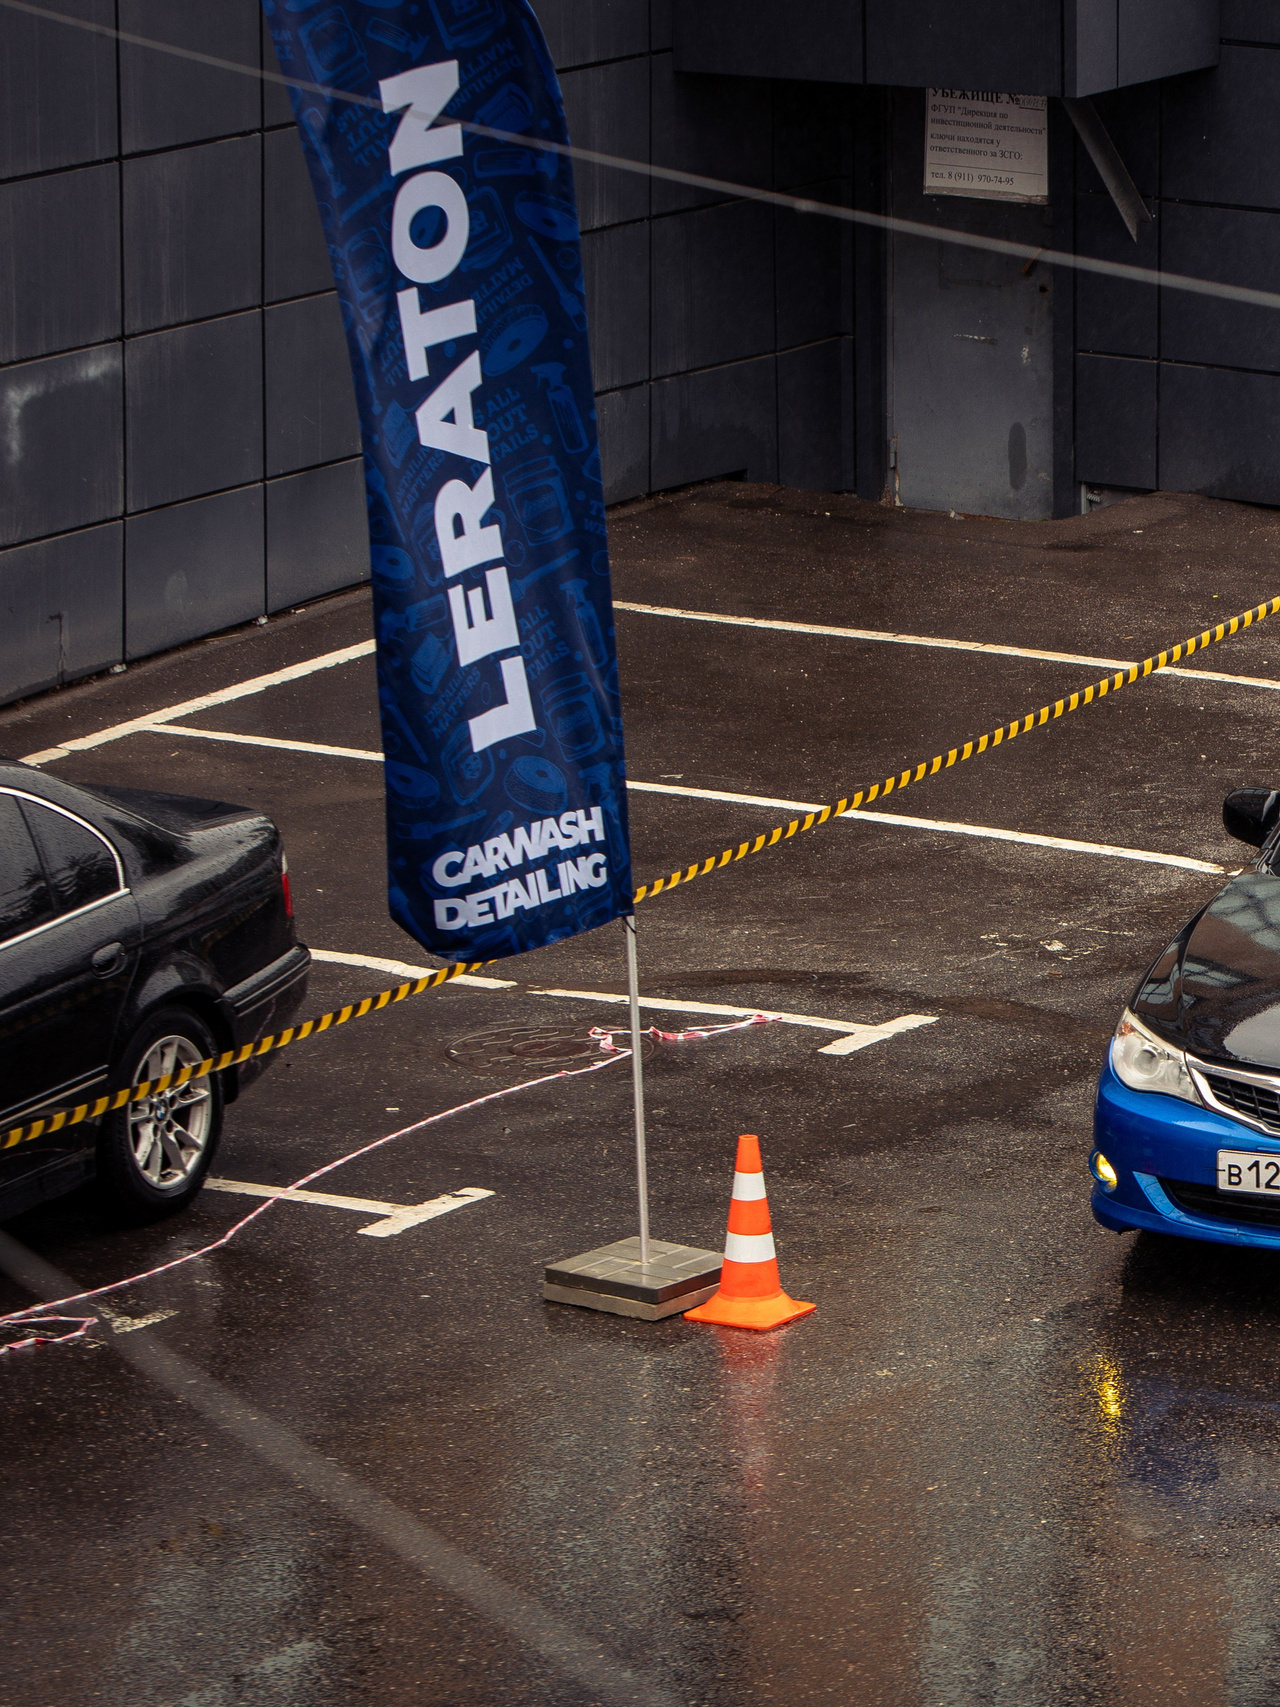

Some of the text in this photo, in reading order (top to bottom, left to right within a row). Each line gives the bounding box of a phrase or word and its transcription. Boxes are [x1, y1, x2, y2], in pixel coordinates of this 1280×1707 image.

[931, 104, 956, 114] ФГУП
[957, 107, 997, 118] "Дирекция
[930, 118, 1046, 135] инвестиционной деятельности"
[930, 133, 1001, 147] ключи находятся у
[930, 145, 988, 156] ответственного
[931, 171, 1014, 186] тел. 8 (911) 970-74-95
[378, 58, 537, 753] LERATON
[432, 805, 606, 888] CARWASH
[433, 852, 608, 931] DETAILING
